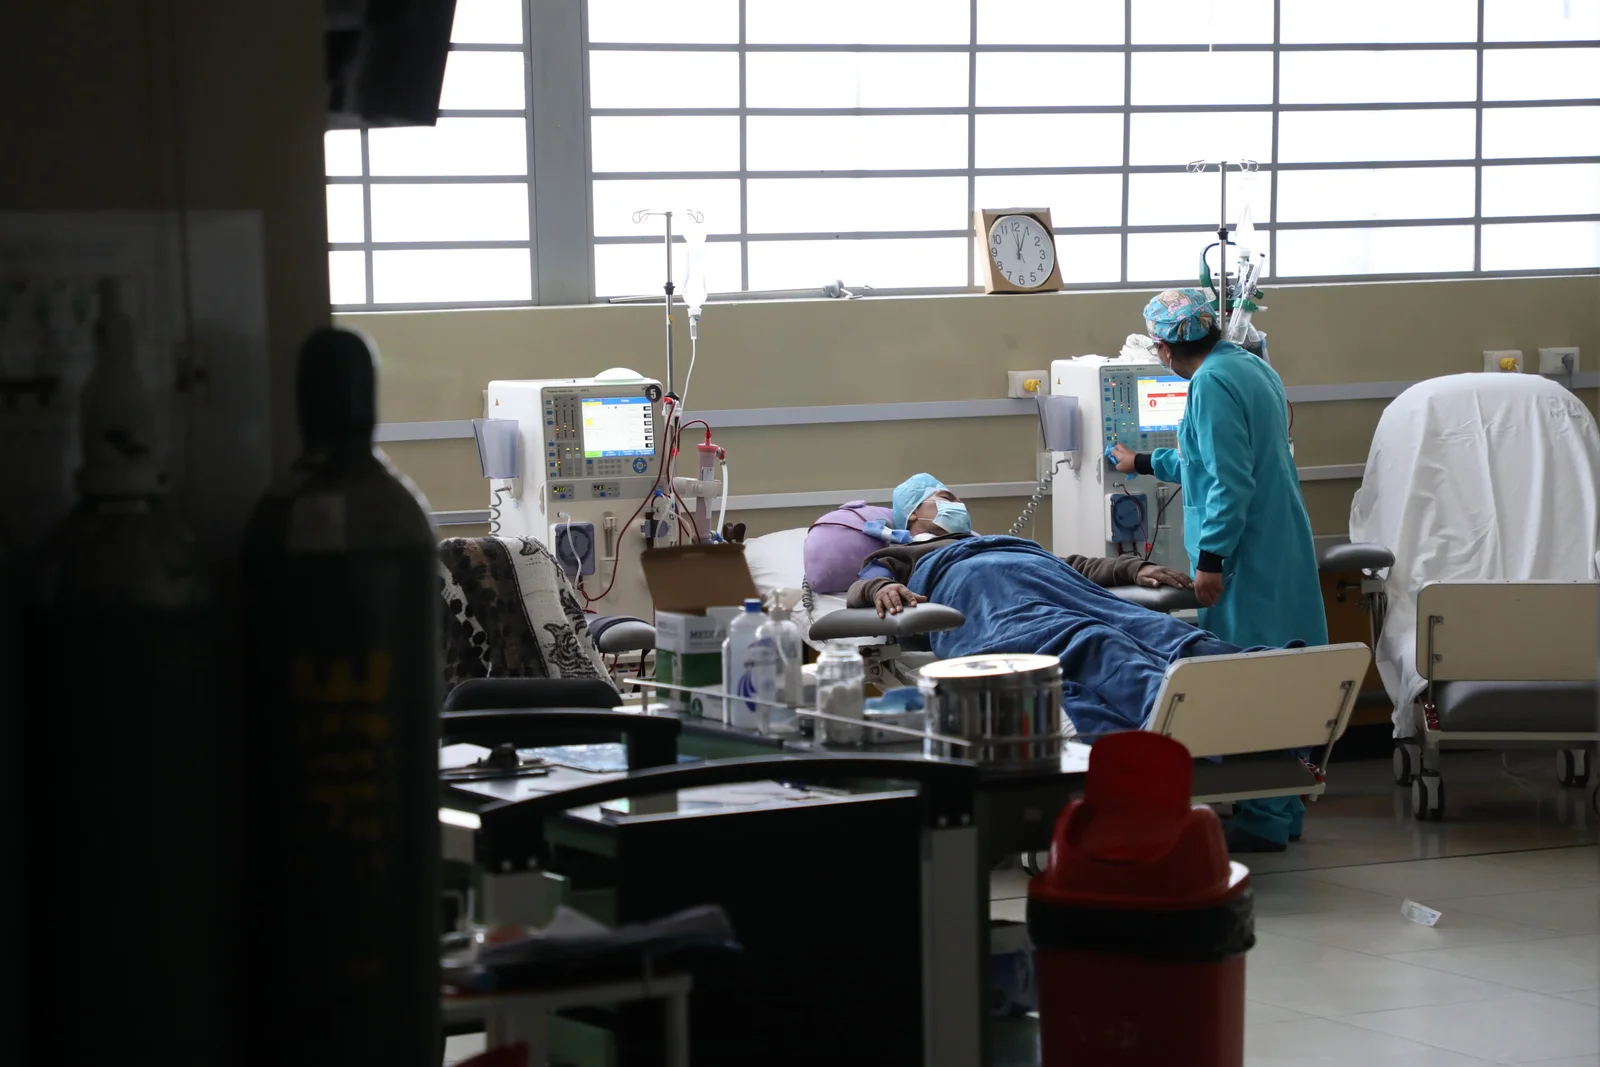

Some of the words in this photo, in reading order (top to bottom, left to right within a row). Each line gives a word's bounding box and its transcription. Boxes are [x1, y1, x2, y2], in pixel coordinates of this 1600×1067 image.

[1000, 225, 1007, 234] 11
[1011, 222, 1020, 232] 12
[992, 234, 1001, 244] 10
[1034, 236, 1040, 246] 2
[991, 247, 998, 257] 9
[1039, 249, 1046, 259] 3
[996, 261, 1003, 271] 8
[1037, 263, 1043, 272] 4
[1006, 271, 1012, 280] 7
[1018, 275, 1025, 285] 6
[1030, 272, 1036, 282] 5
[650, 388, 657, 399] 5
